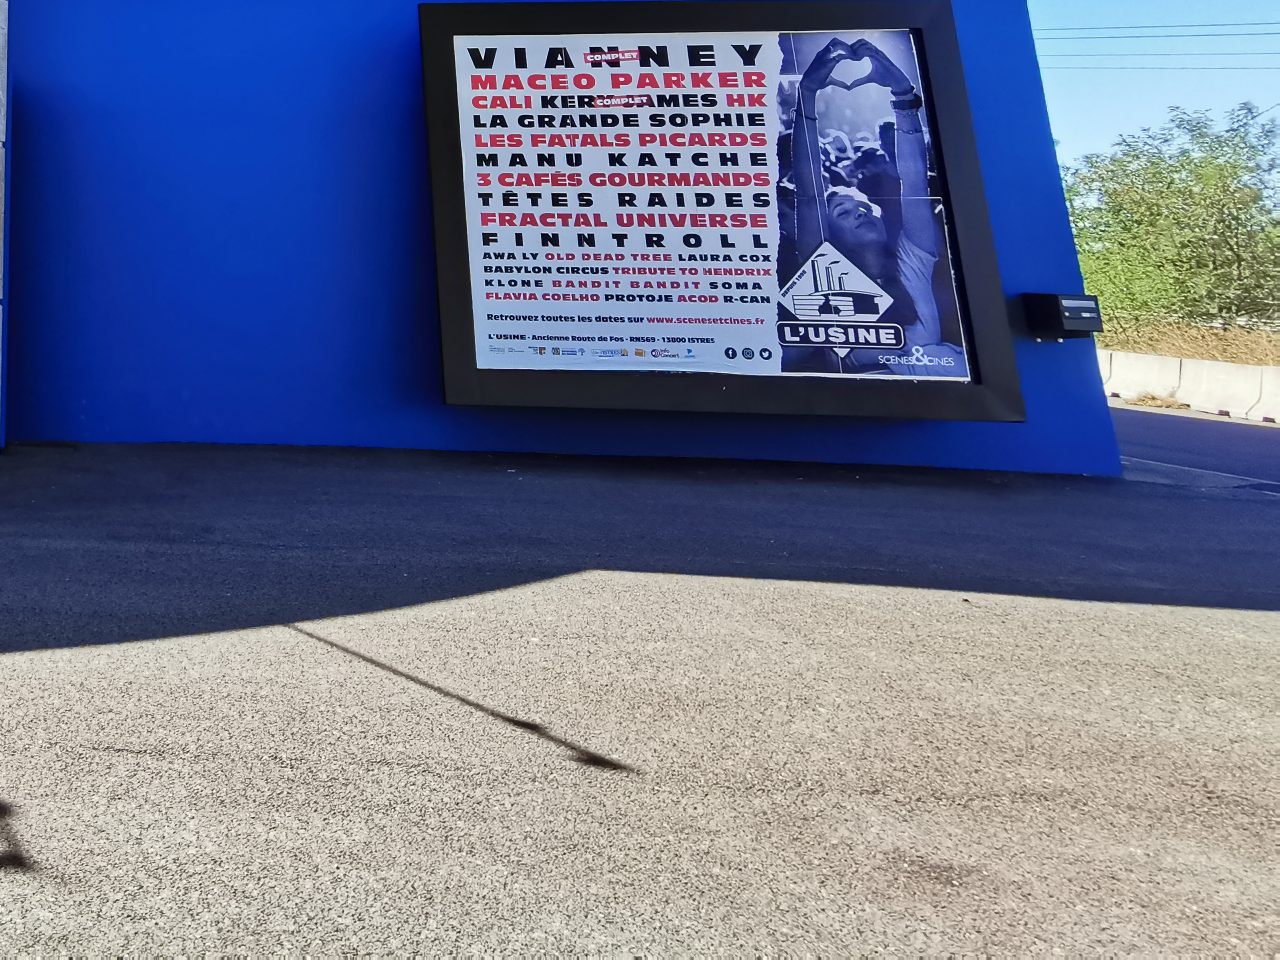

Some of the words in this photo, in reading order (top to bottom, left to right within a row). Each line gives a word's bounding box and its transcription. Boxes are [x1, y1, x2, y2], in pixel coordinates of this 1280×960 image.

[467, 45, 762, 69] VIANNEY
[586, 52, 638, 61] COMPLET
[471, 73, 596, 90] MACEO
[611, 72, 767, 89] PARKER
[472, 95, 532, 109] CALI
[726, 93, 767, 107] HK
[596, 97, 648, 106] COMPLET
[473, 115, 508, 128] LA
[518, 114, 640, 128] GRANDE
[649, 113, 766, 127] SOPHIE
[475, 134, 523, 147] LES
[531, 134, 631, 147] FATALS
[639, 133, 767, 147] PICARDS
[476, 153, 582, 167] MANU
[608, 153, 768, 167] KATCHE
[476, 173, 492, 187] 3
[498, 171, 583, 187] CAFÉS
[589, 173, 771, 187] GOURMANDS
[478, 190, 594, 207] TÊTES
[617, 193, 771, 207] RAIDES
[480, 213, 608, 227] FRACTAL
[616, 213, 768, 227] UNIVERSE
[482, 233, 769, 248] FINNTROLL
[483, 252, 517, 260] AWA
[545, 253, 576, 261] OLD
[582, 253, 625, 261] DEAD
[678, 254, 734, 262] LAURA
[738, 254, 772, 262] COX
[483, 266, 552, 274] BABYLON
[613, 267, 676, 275] TRIBUTE
[703, 268, 772, 276] HENDRIX
[484, 279, 543, 288] KLONE
[552, 280, 621, 288] BANDIT
[630, 281, 701, 289] BANDIT
[709, 282, 763, 290] SOMA
[542, 293, 600, 301] COELHO
[605, 294, 673, 302] PROTOJE
[677, 295, 719, 303] ACOD
[723, 295, 771, 303] R-CAN
[541, 314, 575, 322] toutes
[646, 316, 765, 325] www.scenesetcines.fr
[531, 334, 570, 342] Ancienne
[784, 326, 897, 344] L'USINE
